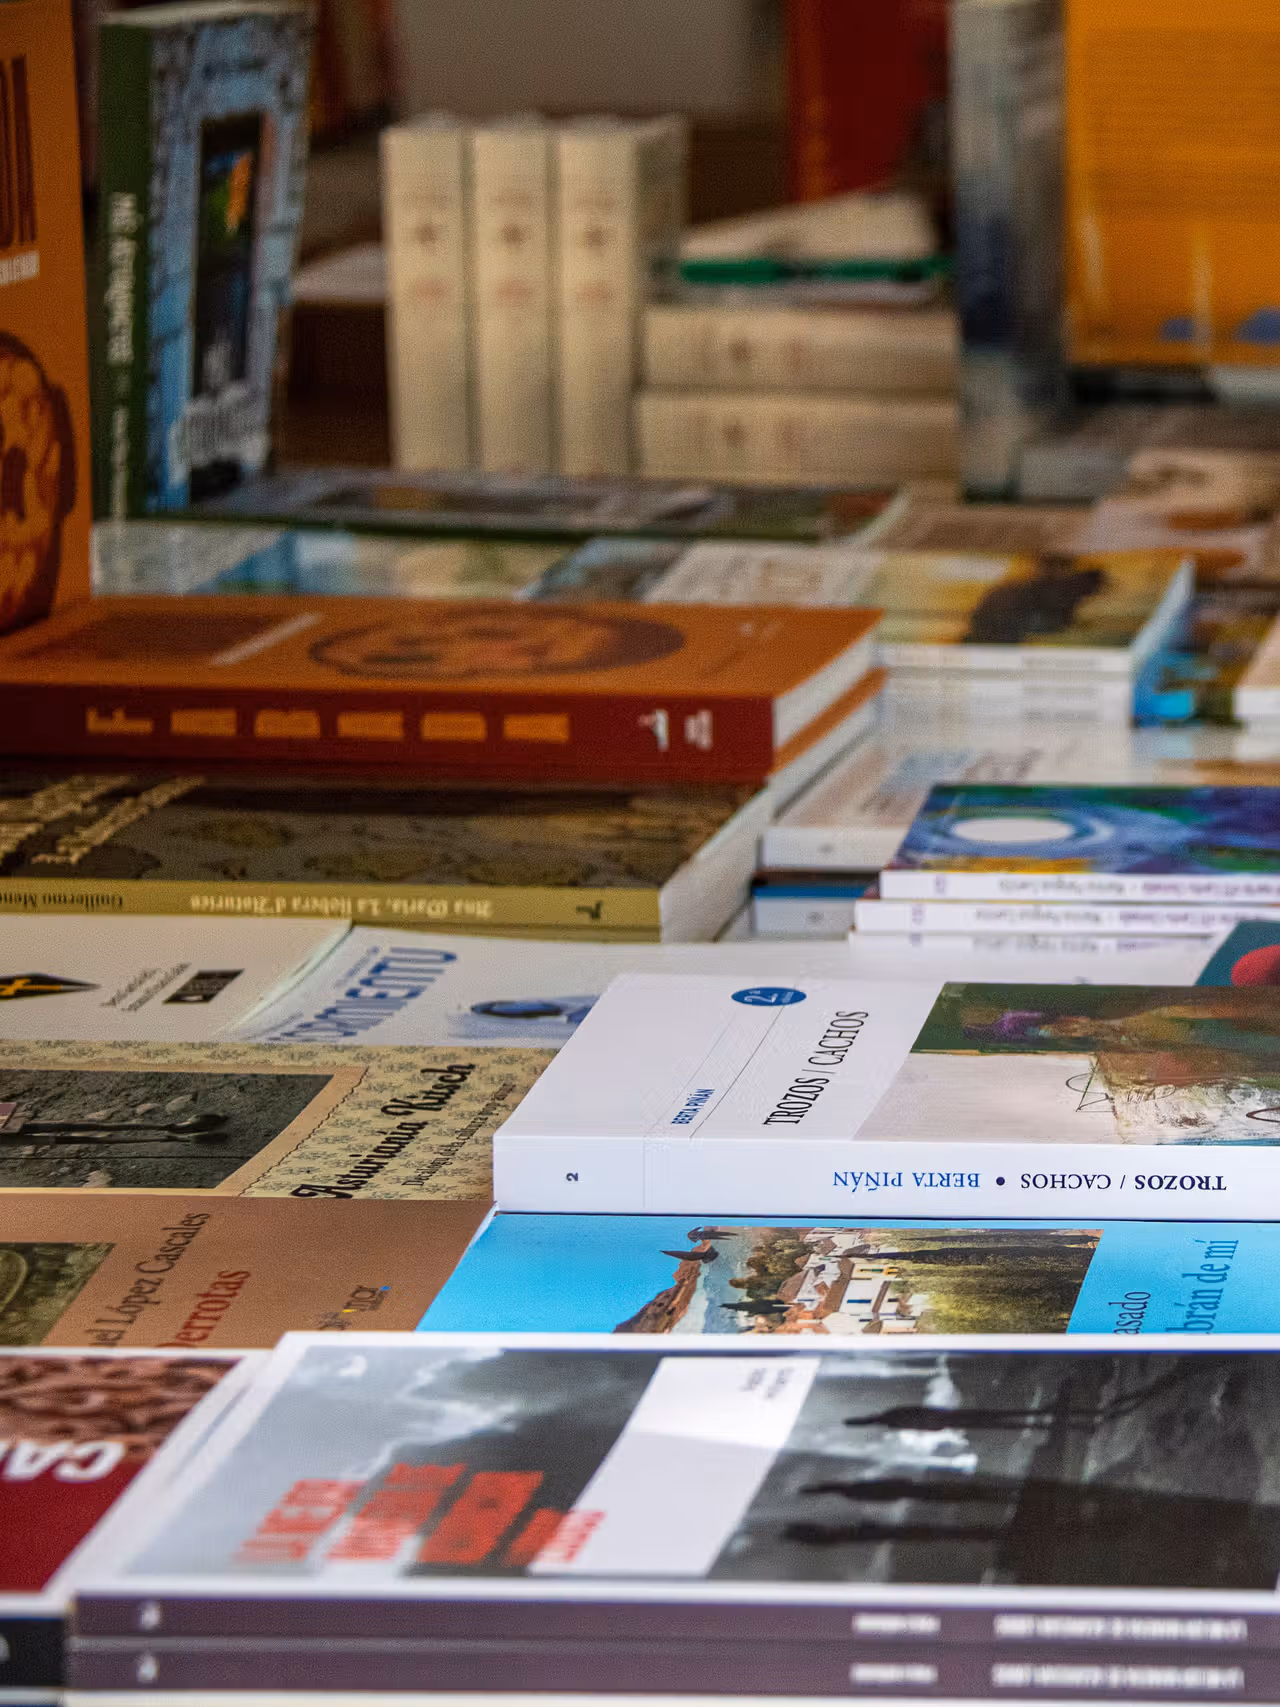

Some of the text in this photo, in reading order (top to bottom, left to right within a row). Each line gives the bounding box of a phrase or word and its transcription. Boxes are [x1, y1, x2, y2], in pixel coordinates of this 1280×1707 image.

[761, 1077, 830, 1126] TROZOS
[807, 1010, 869, 1066] CACHOS
[670, 1107, 701, 1125] BERTA
[832, 1171, 903, 1193] PIÑÁN
[911, 1172, 981, 1189] BERTA
[1020, 1173, 1112, 1190] CACHOS
[1134, 1174, 1228, 1192] TROZOS
[1194, 1239, 1240, 1260] mí
[94, 1277, 163, 1325] López
[135, 1212, 211, 1274] Cascales
[1181, 1263, 1231, 1284] de
[0, 1440, 126, 1485] CA
